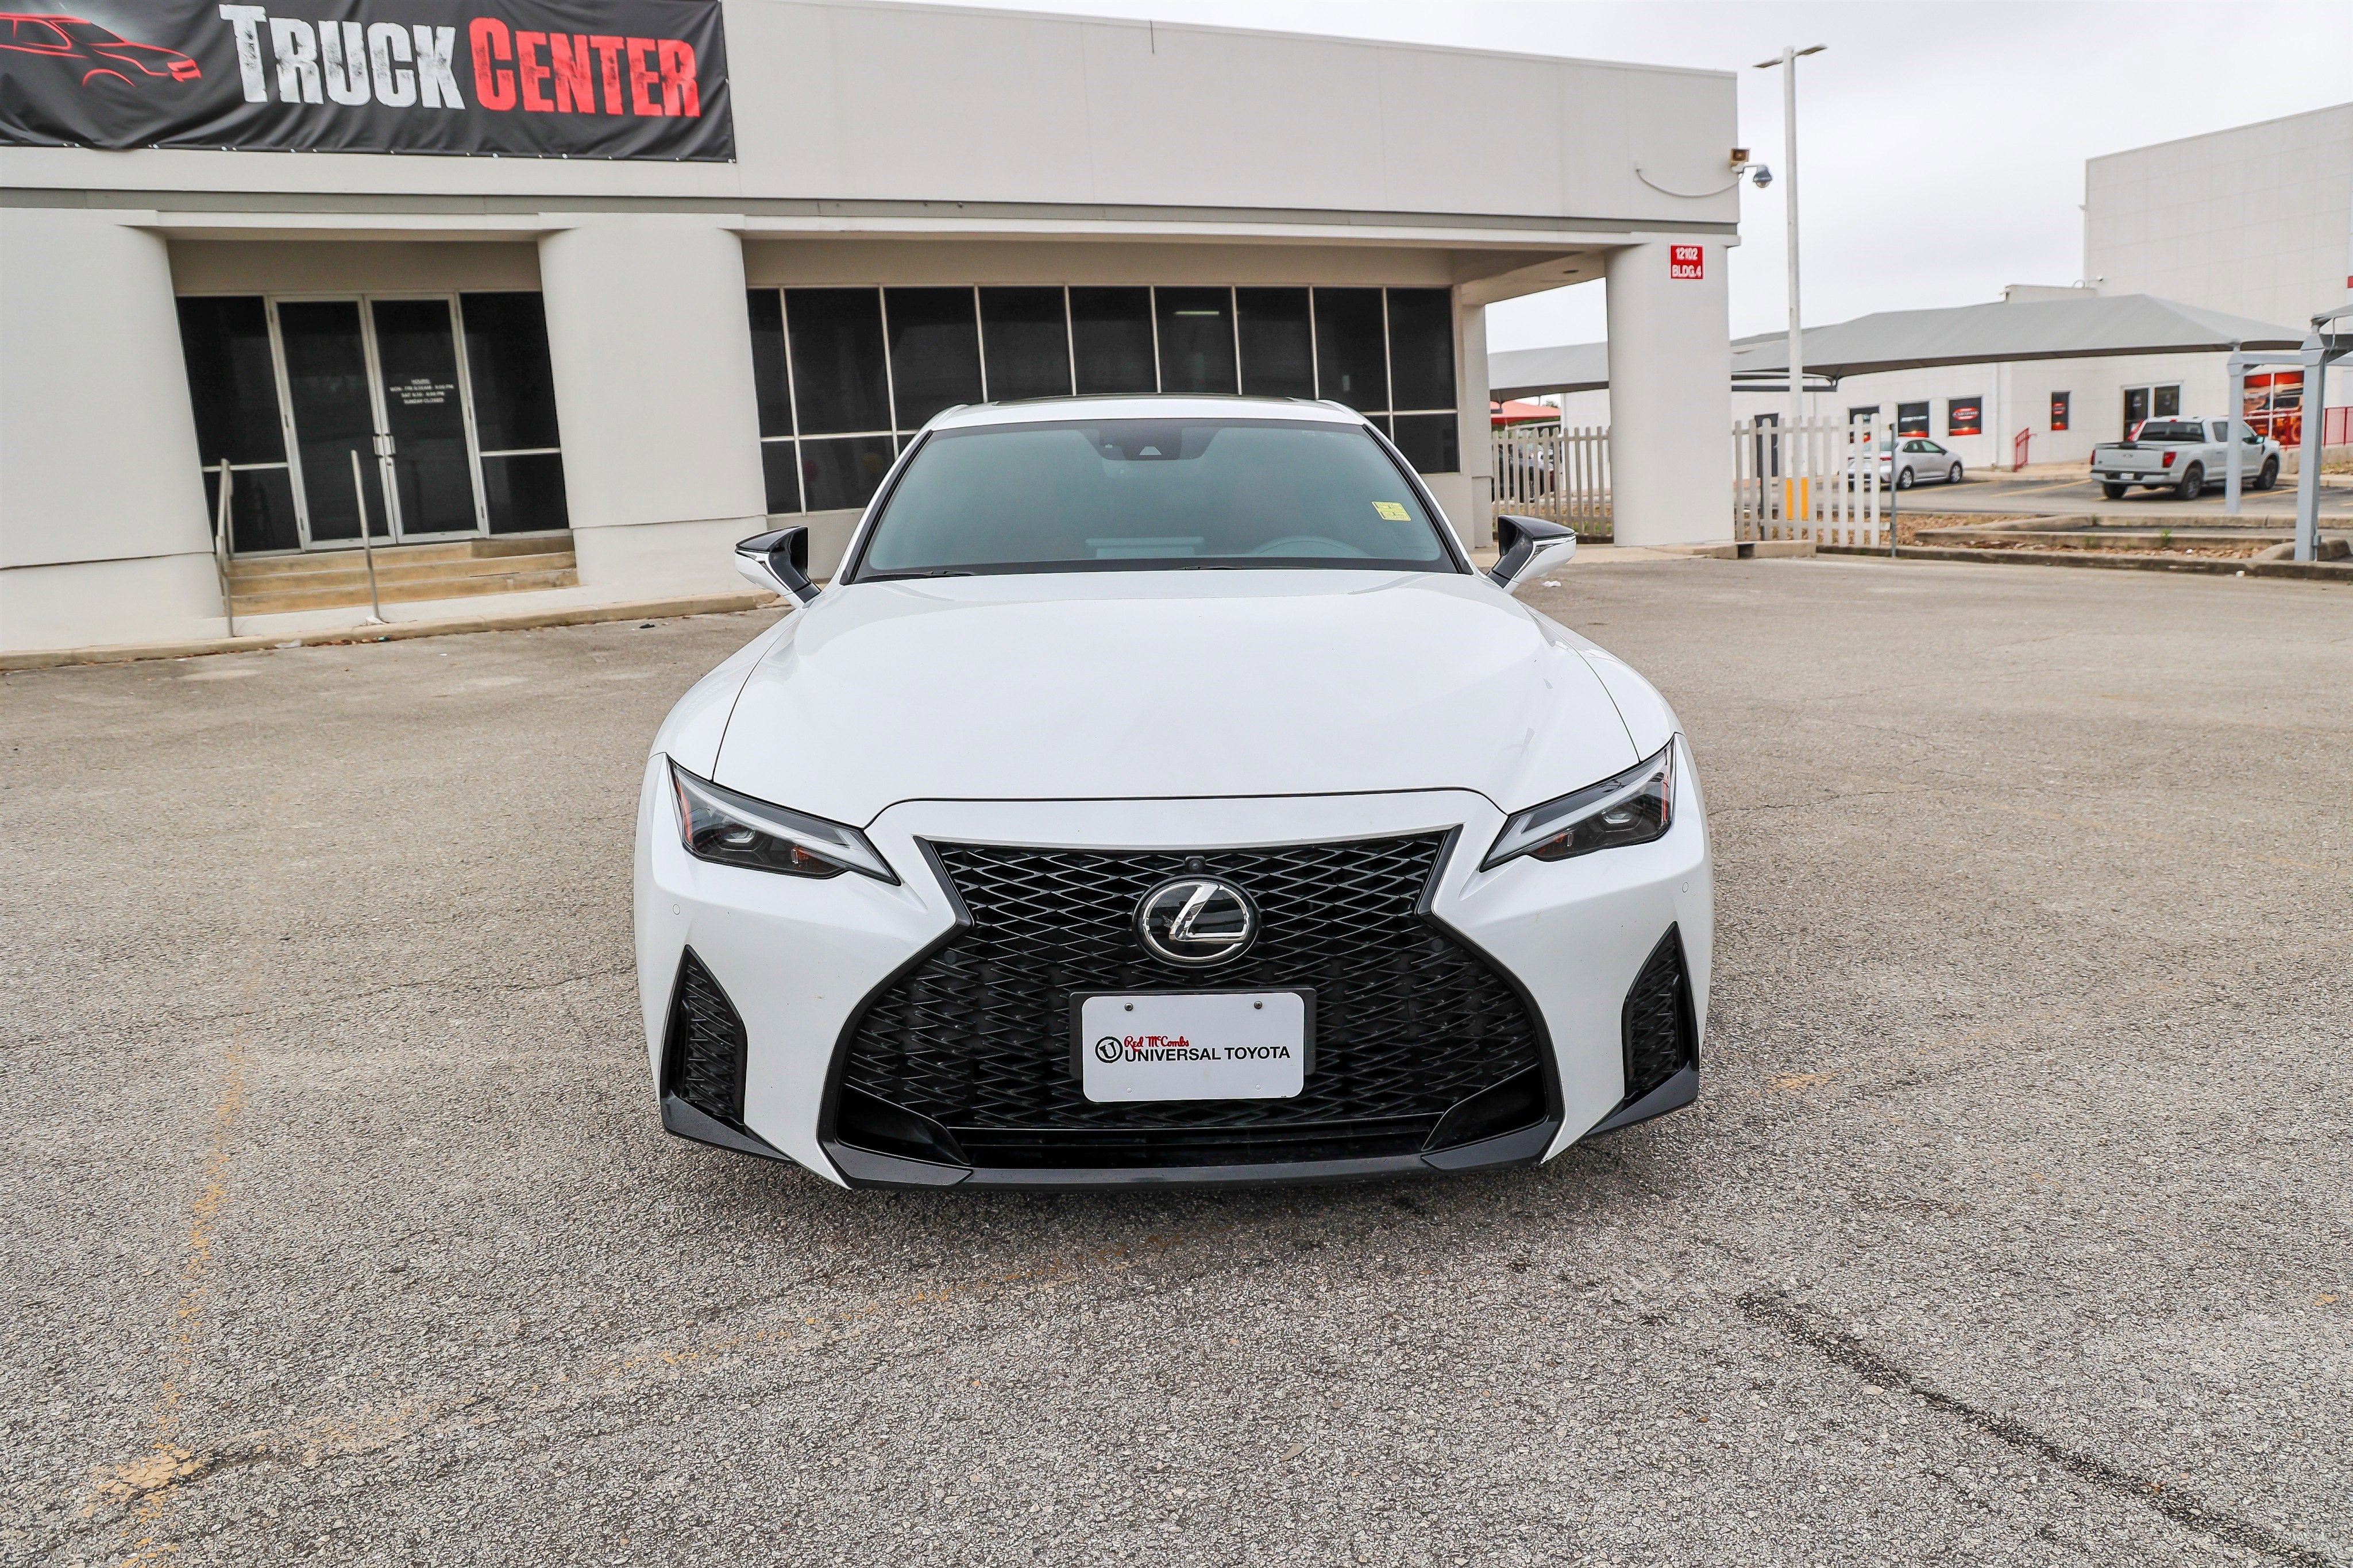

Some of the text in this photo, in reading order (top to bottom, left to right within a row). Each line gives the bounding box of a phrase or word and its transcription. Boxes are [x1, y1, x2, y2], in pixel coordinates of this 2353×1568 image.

[218, 4, 701, 118] TRUCK CENTER
[1676, 247, 1698, 260] 12102
[1124, 1036, 1144, 1052] Red
[1125, 1046, 1291, 1062] UNIVERSAL TOYOTA
